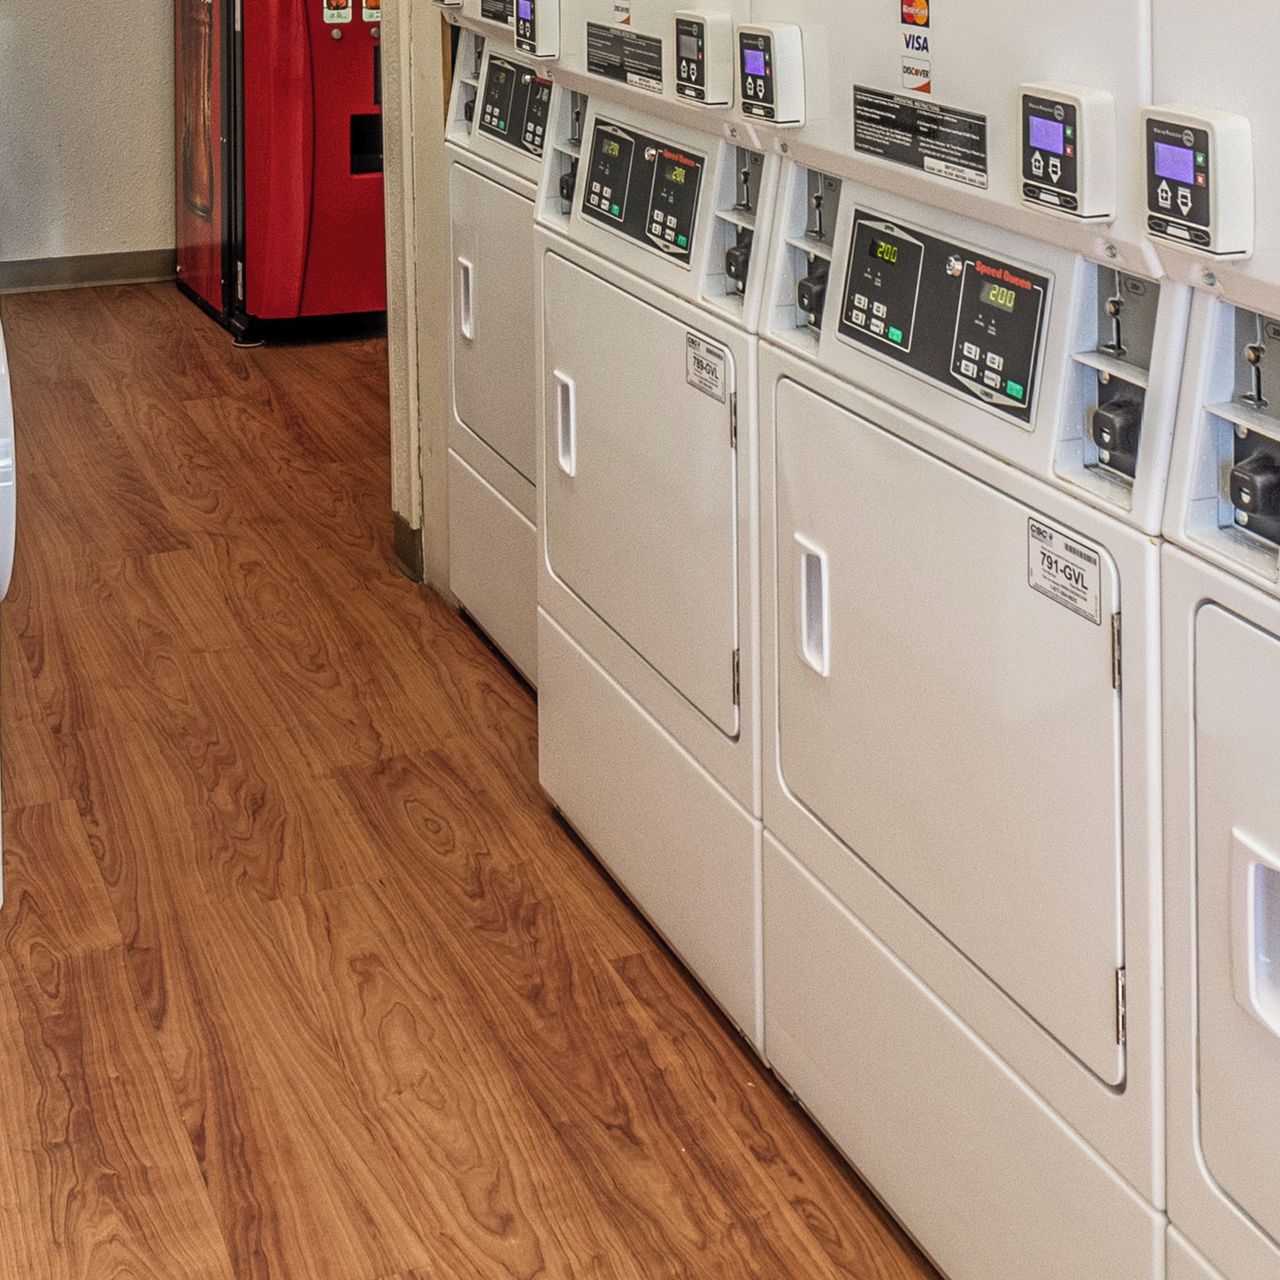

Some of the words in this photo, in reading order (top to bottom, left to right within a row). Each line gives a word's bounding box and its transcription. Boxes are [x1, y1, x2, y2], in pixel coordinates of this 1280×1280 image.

[902, 32, 929, 53] VISA
[903, 65, 929, 79] DISCOVER
[877, 242, 898, 264] 200
[975, 260, 1002, 280] Speed
[1003, 270, 1032, 290] Queen
[989, 284, 1016, 307] 200
[1030, 524, 1047, 539] CSC
[1040, 550, 1088, 590] 791-GVL
